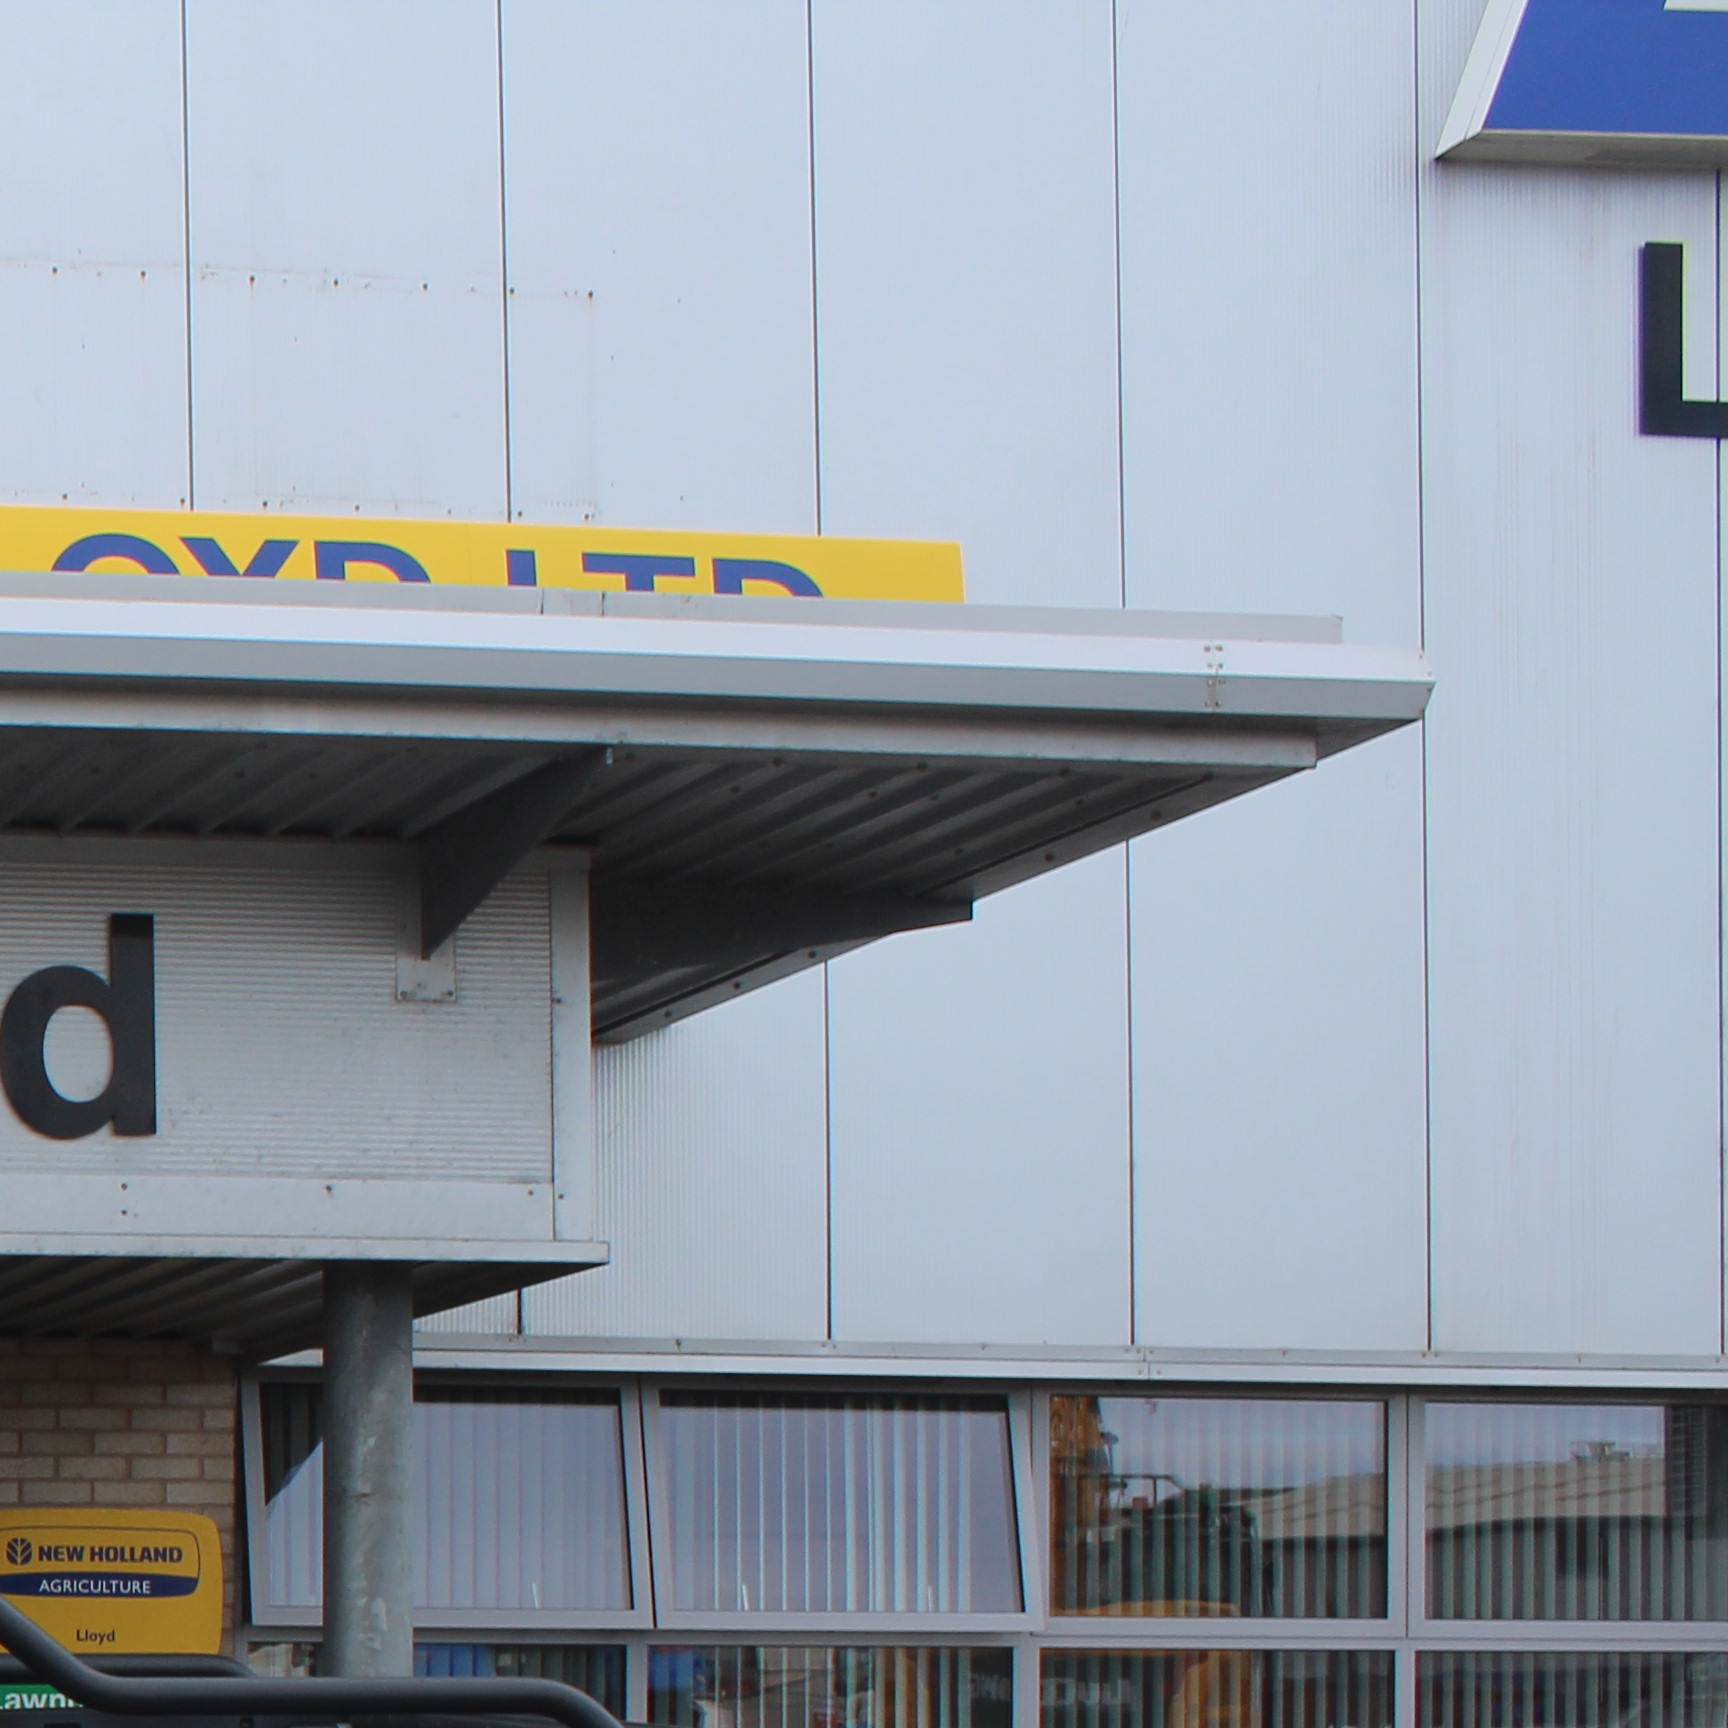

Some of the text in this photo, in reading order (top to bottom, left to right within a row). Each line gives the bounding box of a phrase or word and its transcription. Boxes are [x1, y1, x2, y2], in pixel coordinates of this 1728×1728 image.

[38, 1545, 183, 1564] NEW HOLLAND
[39, 1579, 151, 1595] AGRICULTURE
[76, 1628, 116, 1644] Lloyd
